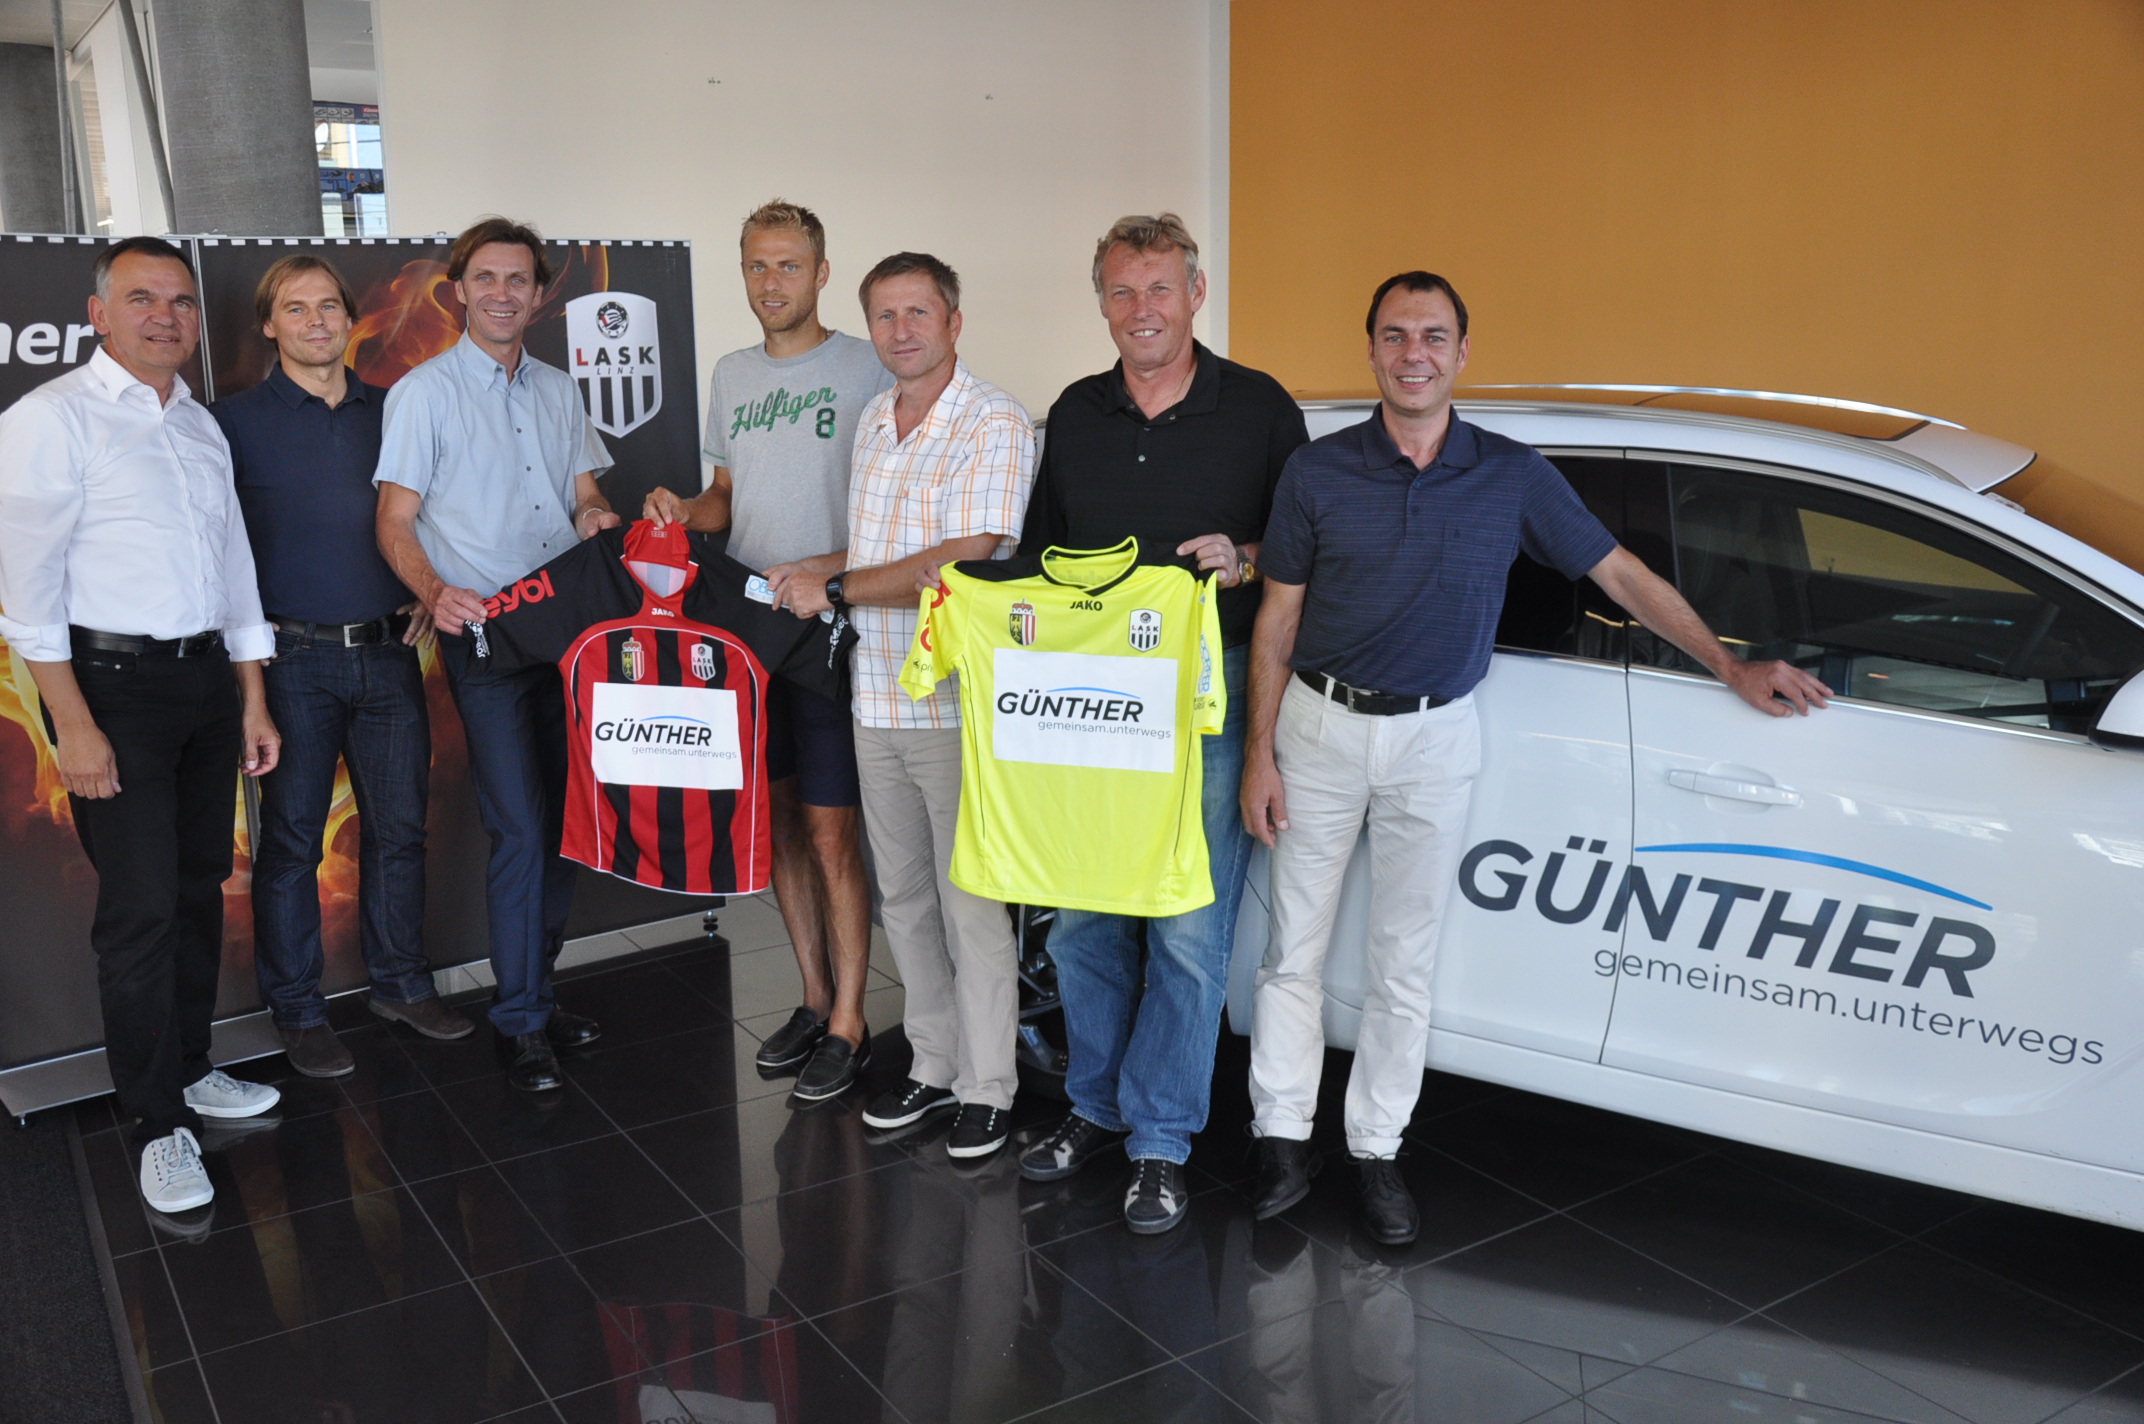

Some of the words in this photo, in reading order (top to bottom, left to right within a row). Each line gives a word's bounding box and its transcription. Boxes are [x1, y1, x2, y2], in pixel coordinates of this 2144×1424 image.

[576, 346, 655, 366] LASK
[597, 366, 635, 375] LINZ
[729, 387, 837, 440] Hilfiger
[815, 407, 836, 439] 8
[480, 569, 556, 619] eybl
[1070, 600, 1103, 611] JAKO
[997, 689, 1144, 722] GÜNTHER
[595, 718, 712, 746] GÜNTHER
[1038, 721, 1171, 740] gemeinsam.unterwegs
[632, 746, 737, 760] gemeinsam.unterwegs
[1457, 835, 1997, 999] GÜNTHER
[1593, 946, 2105, 1065] gemeinsam.unterwegs
